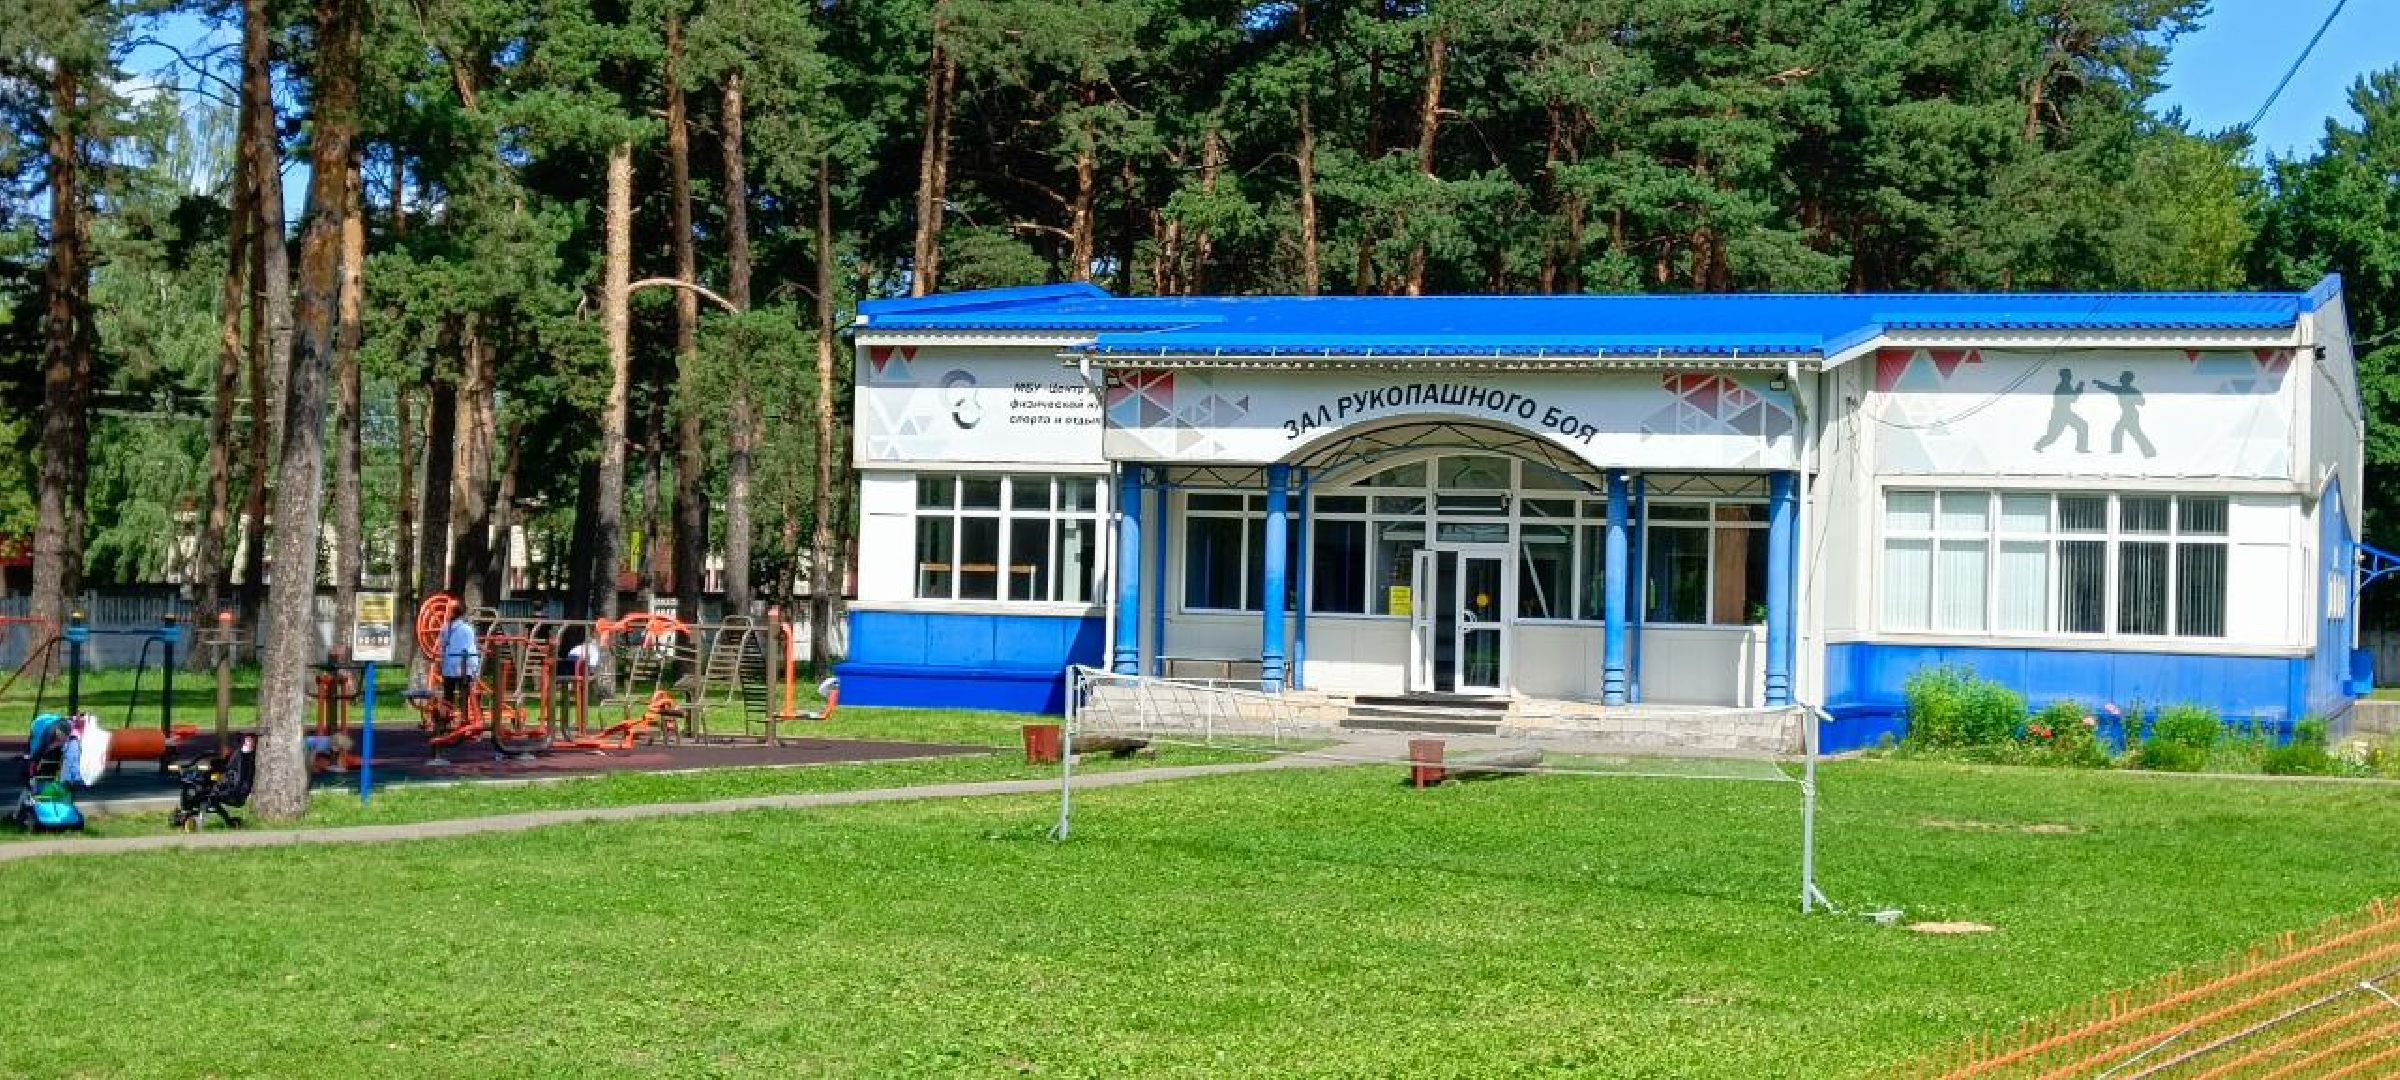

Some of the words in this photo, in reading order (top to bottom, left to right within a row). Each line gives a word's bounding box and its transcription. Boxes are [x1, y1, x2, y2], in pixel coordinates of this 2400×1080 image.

[1010, 416, 1050, 425] спорта
[1283, 404, 1332, 440] ЗАЛ
[1337, 383, 1538, 419] РУКОПАШНОГО
[1541, 405, 1599, 445] БОЯ
